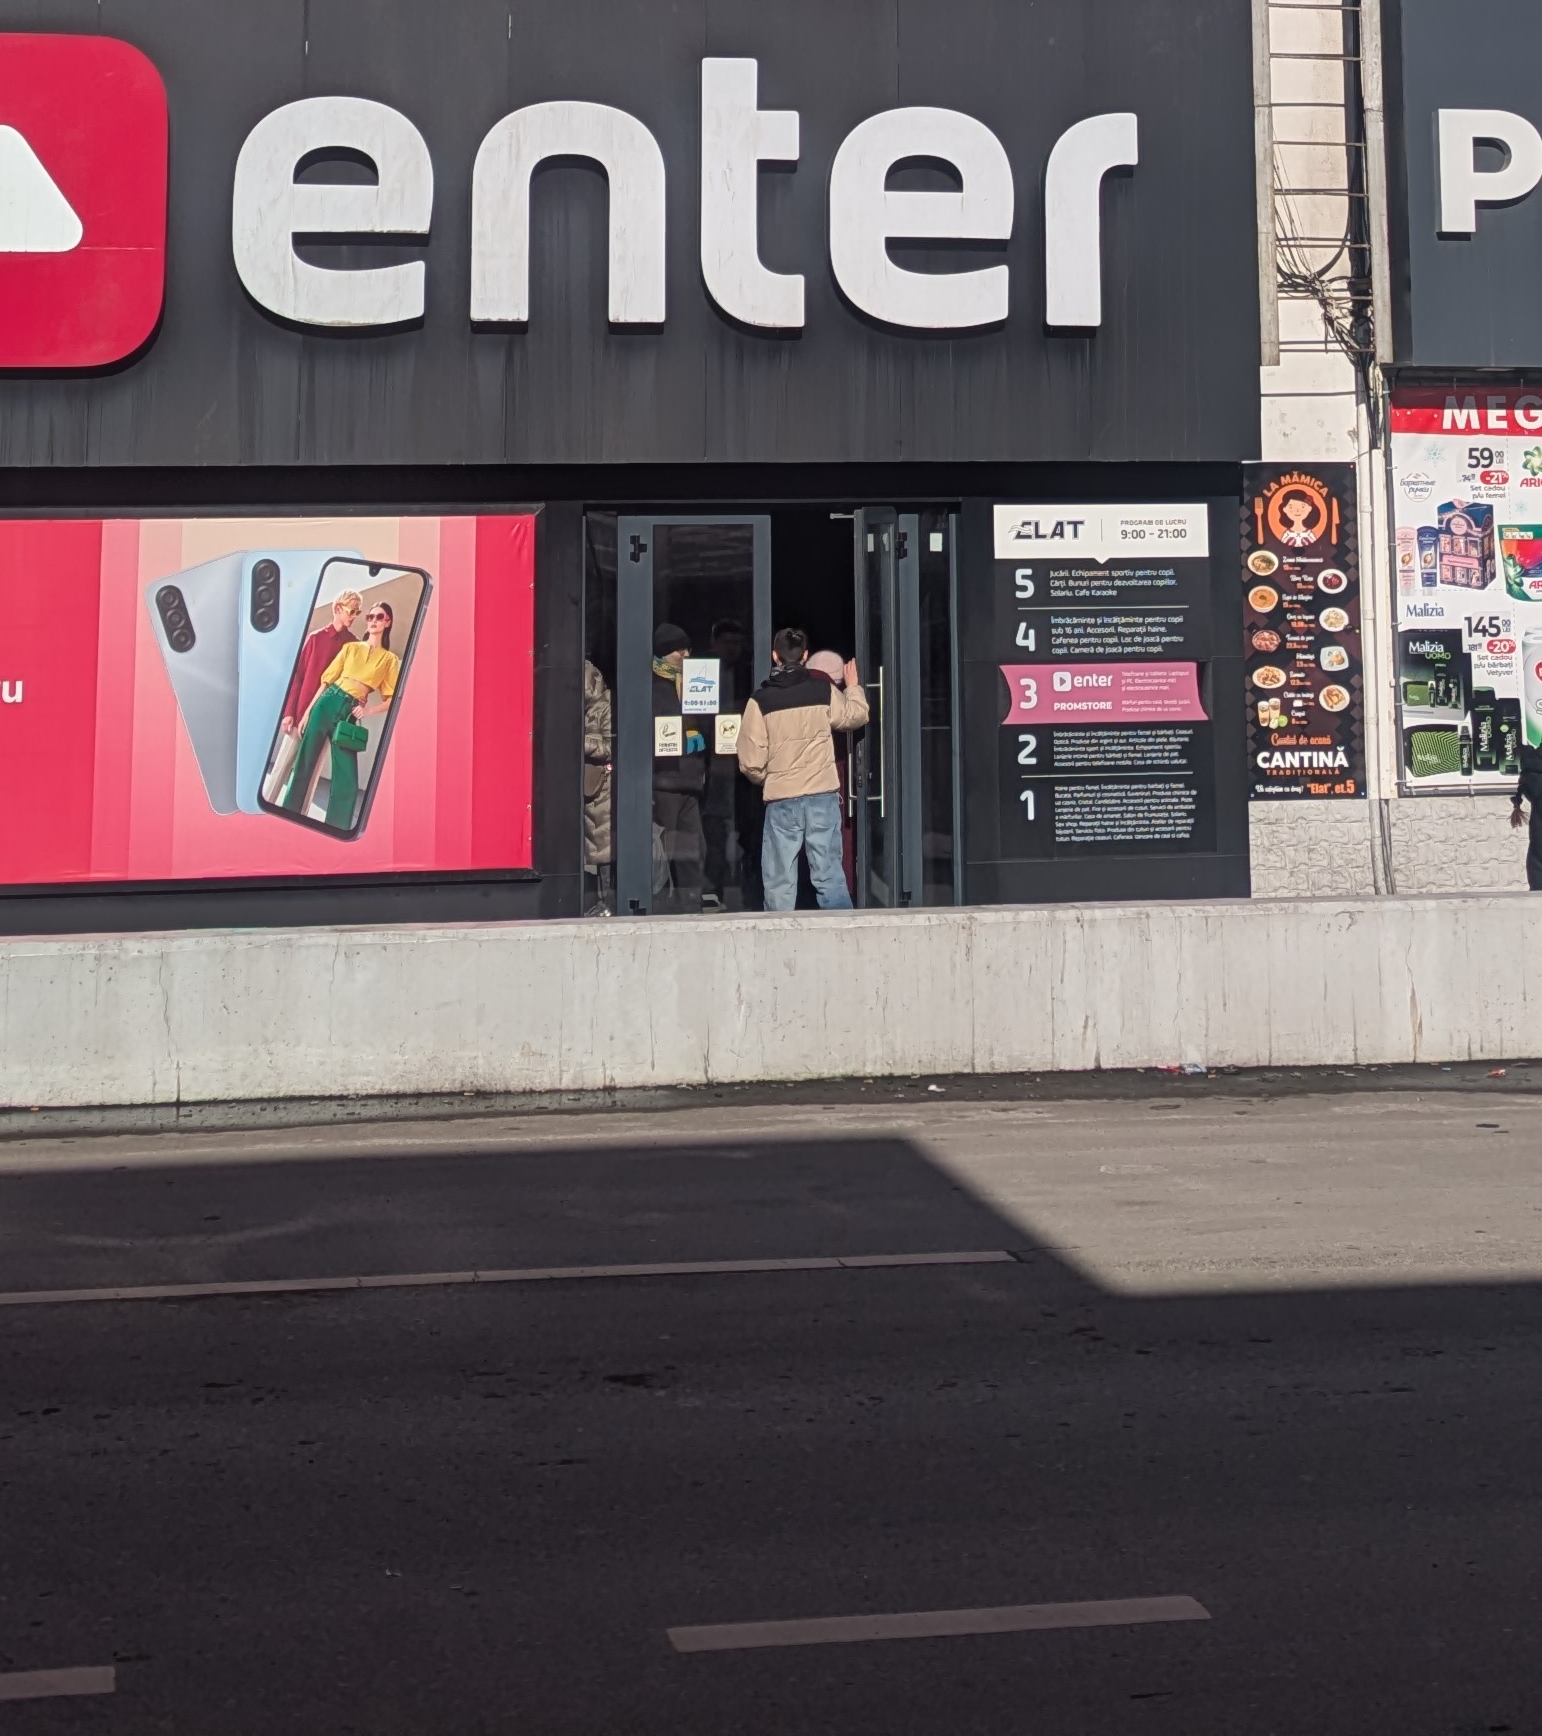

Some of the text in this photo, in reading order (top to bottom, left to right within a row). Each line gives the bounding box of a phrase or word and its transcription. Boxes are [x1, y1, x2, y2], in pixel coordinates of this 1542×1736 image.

[231, 56, 1140, 332] enter
[1467, 447, 1494, 468] 59
[1263, 471, 1329, 497] LA MĂMICA
[1011, 519, 1085, 541] ELAT
[1121, 528, 1187, 540] 9:00 21:00
[1015, 568, 1035, 599] 5
[1072, 570, 1110, 578] Echipament
[1111, 569, 1134, 577] sportiv
[1135, 569, 1157, 577] pentru
[1090, 579, 1112, 587] pentru
[1406, 602, 1444, 617] Malizia
[1015, 622, 1036, 652] 4
[1465, 616, 1500, 637] 145
[1409, 641, 1443, 653] Malizia
[1425, 652, 1451, 660] UOMO
[1074, 674, 1113, 687] enter
[1020, 678, 1038, 709] 3
[1054, 702, 1112, 711] PROMSTORE
[1480, 722, 1488, 752] Malizia
[1018, 735, 1037, 764] 2
[1256, 746, 1349, 768] CANTINĂ
[1020, 790, 1035, 820] 1
